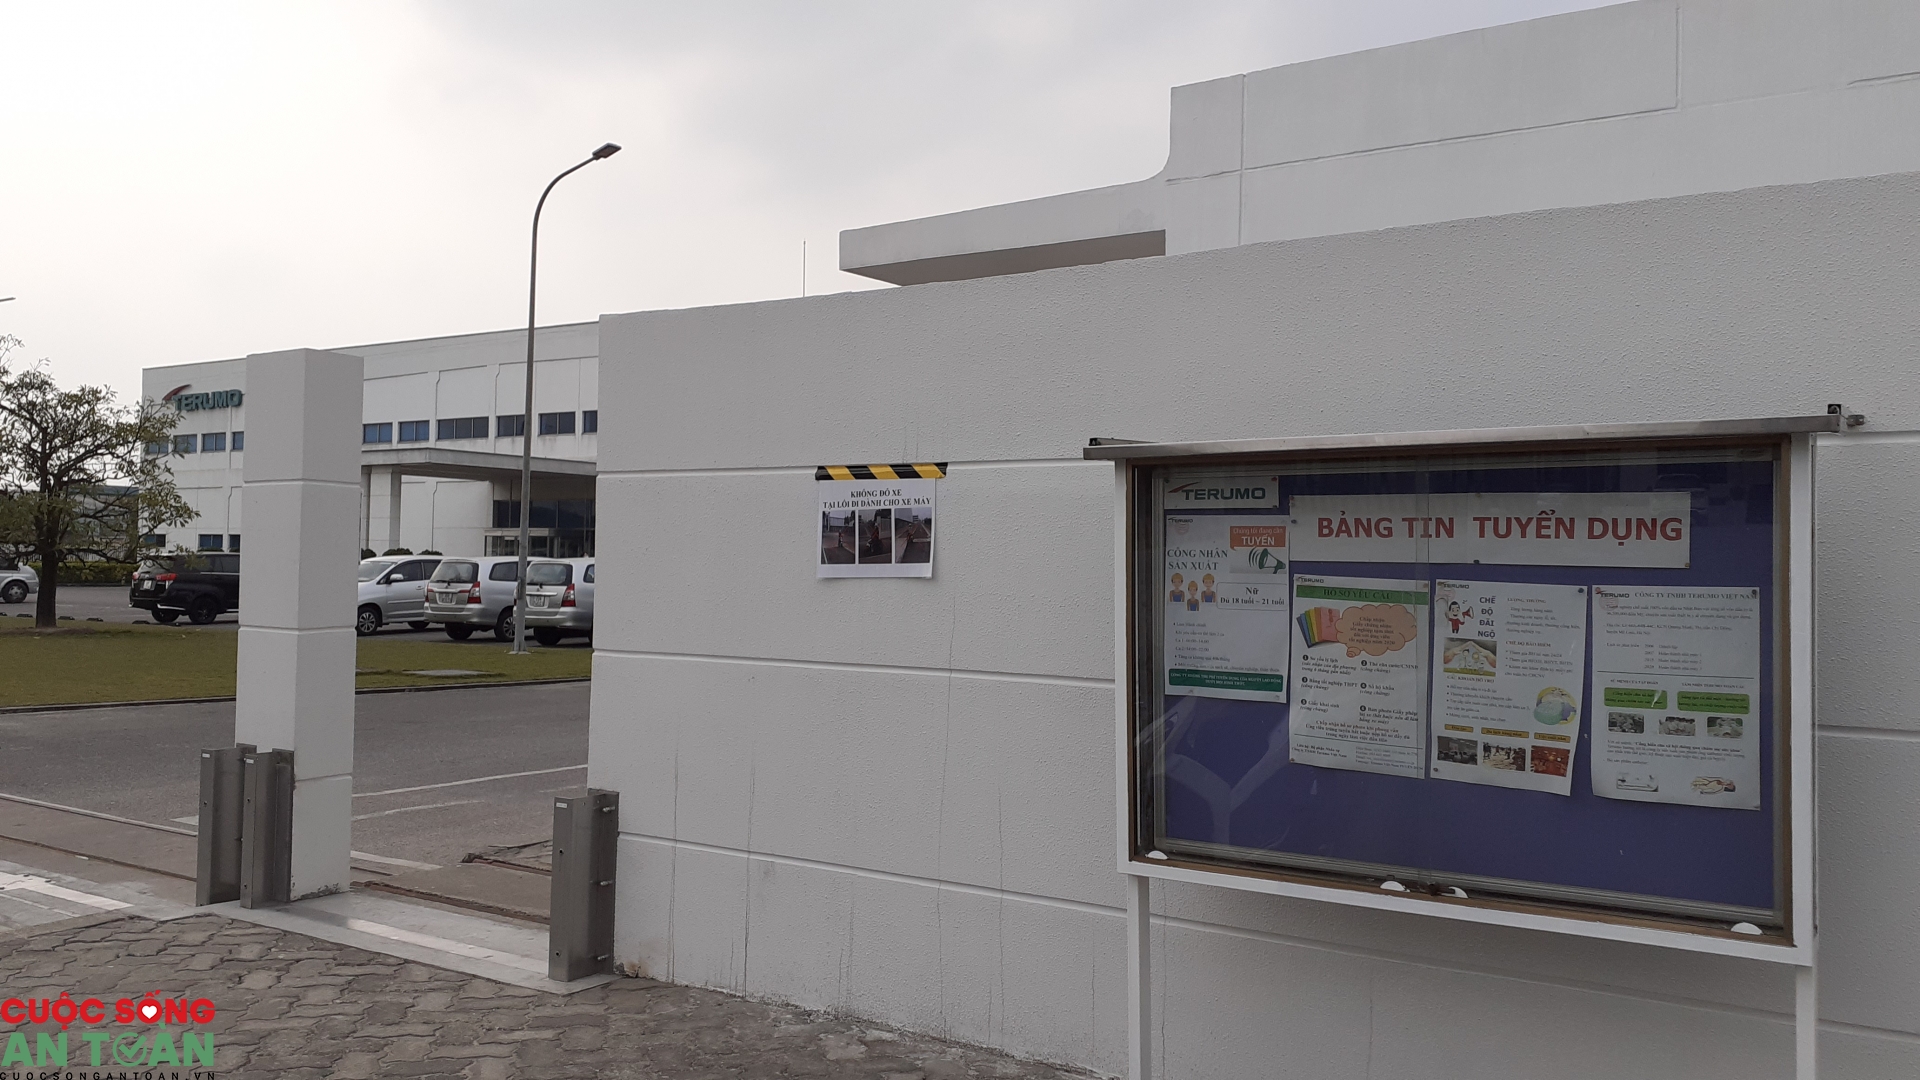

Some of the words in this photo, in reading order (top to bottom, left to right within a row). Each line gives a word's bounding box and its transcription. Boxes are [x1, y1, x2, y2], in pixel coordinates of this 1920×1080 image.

[173, 389, 242, 412] TERUMO
[851, 489, 877, 498] KHÔNG
[1182, 488, 1266, 500] TERUMO
[861, 498, 881, 507] DÀNH
[914, 496, 931, 505] MÁY
[1317, 511, 1392, 538] BẢNG
[1402, 517, 1454, 539] TIN
[1473, 509, 1574, 540] TUYỂN
[1587, 517, 1682, 546] DỤNG
[1167, 547, 1196, 557] CÔNG
[1199, 548, 1228, 557] NHÂN
